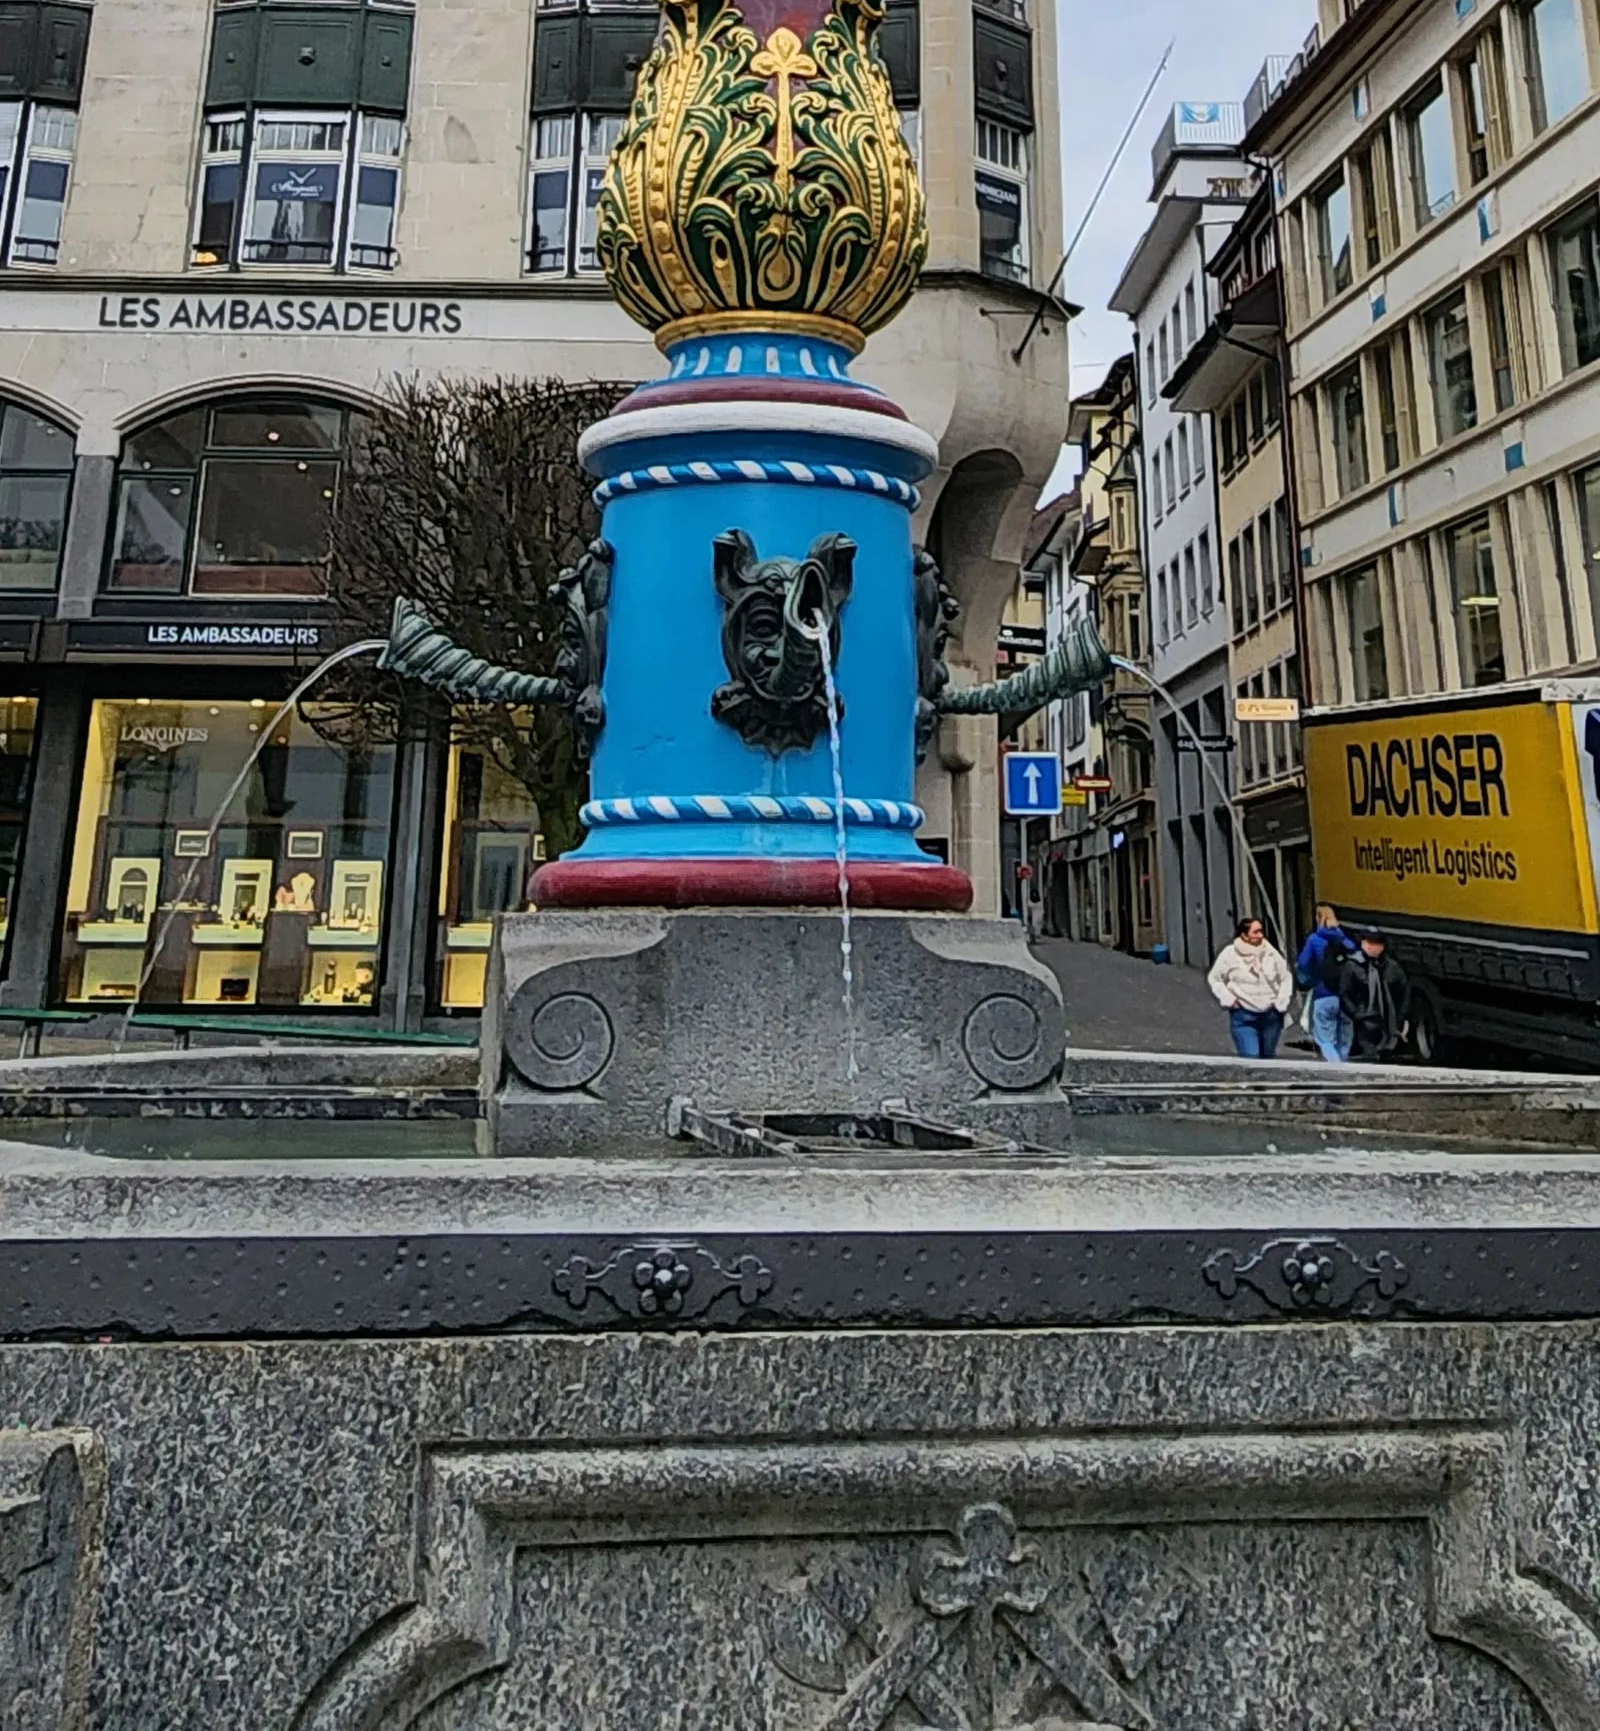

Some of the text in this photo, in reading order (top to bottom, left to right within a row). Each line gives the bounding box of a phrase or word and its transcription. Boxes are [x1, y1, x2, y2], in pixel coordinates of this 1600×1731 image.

[99, 296, 462, 334] LES AMBASSADEURS
[148, 625, 318, 645] LES AMBASSADEURS
[1346, 733, 1509, 817] DACHSER
[1354, 836, 1518, 886] Intelligent Logistics
